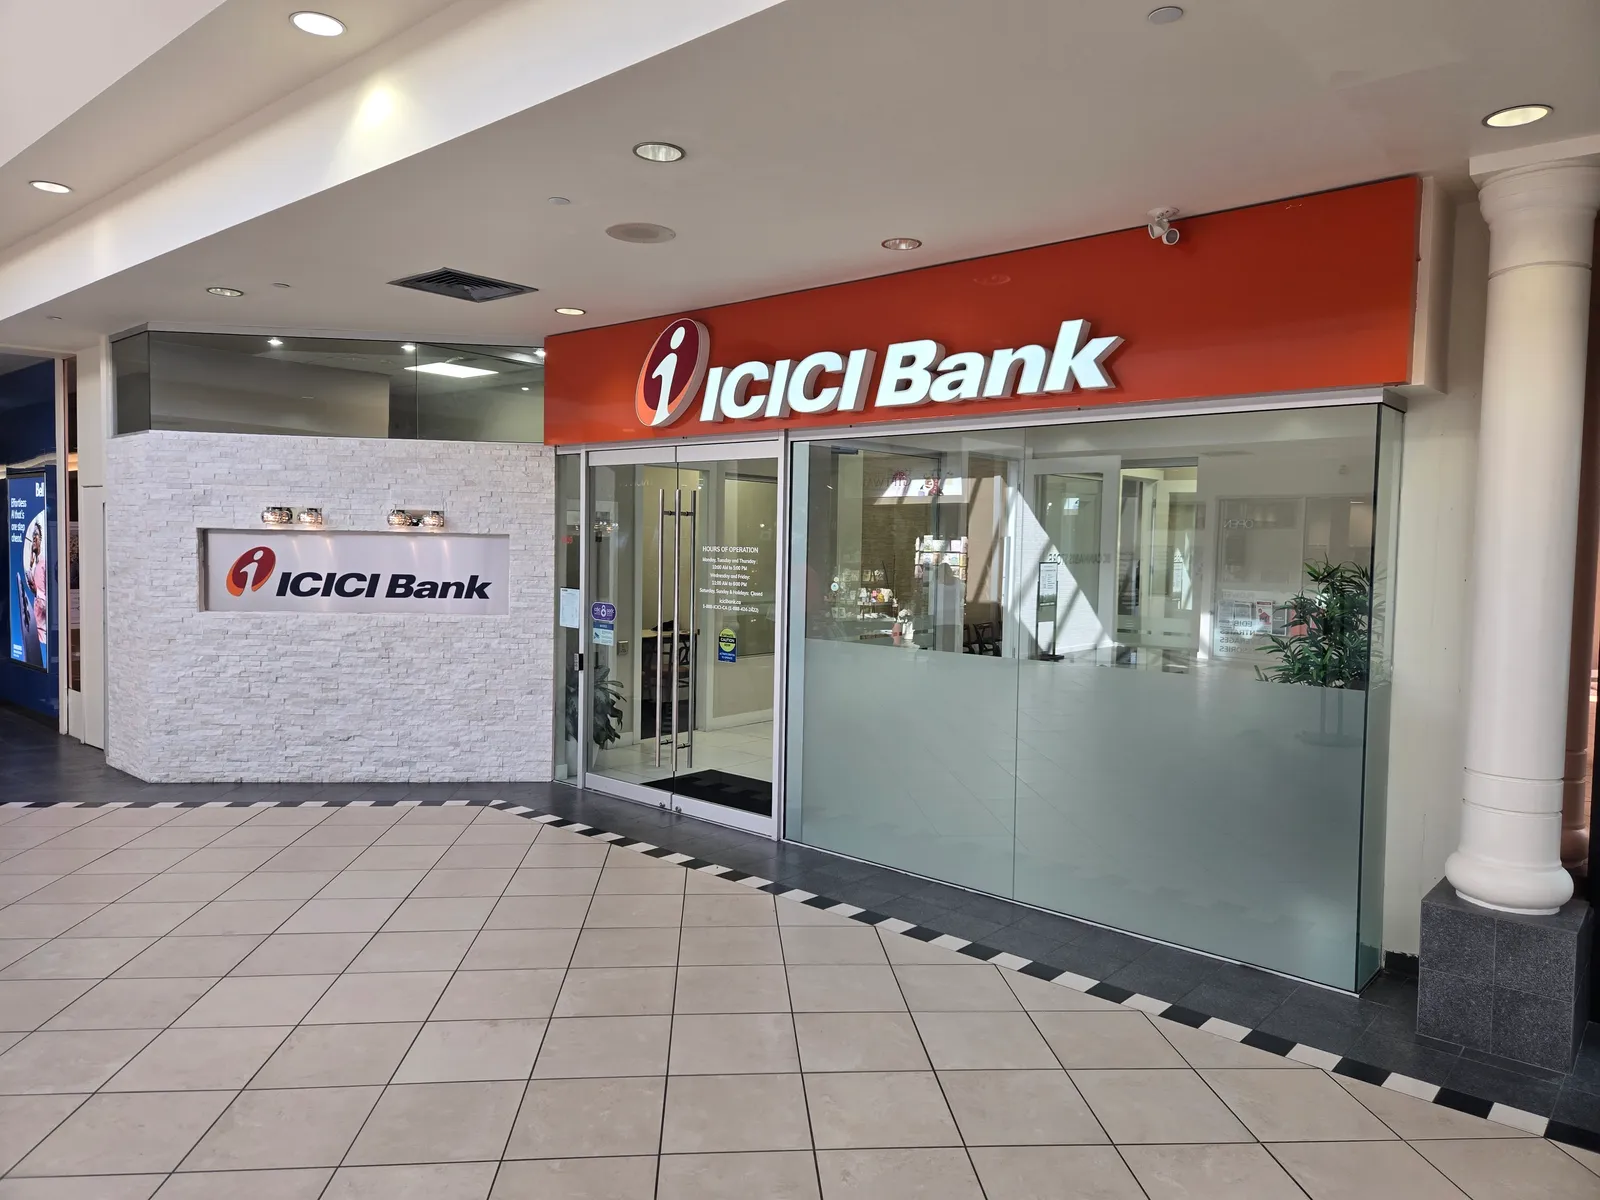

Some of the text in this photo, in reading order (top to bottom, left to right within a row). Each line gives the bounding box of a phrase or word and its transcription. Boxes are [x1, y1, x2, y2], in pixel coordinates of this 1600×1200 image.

[699, 347, 876, 423] ICICI
[875, 318, 1124, 407] Bank
[35, 482, 45, 498] Bell
[10, 497, 26, 508] Effortless
[18, 521, 26, 533] step
[276, 572, 381, 598] ICICI
[385, 574, 492, 600] Bank
